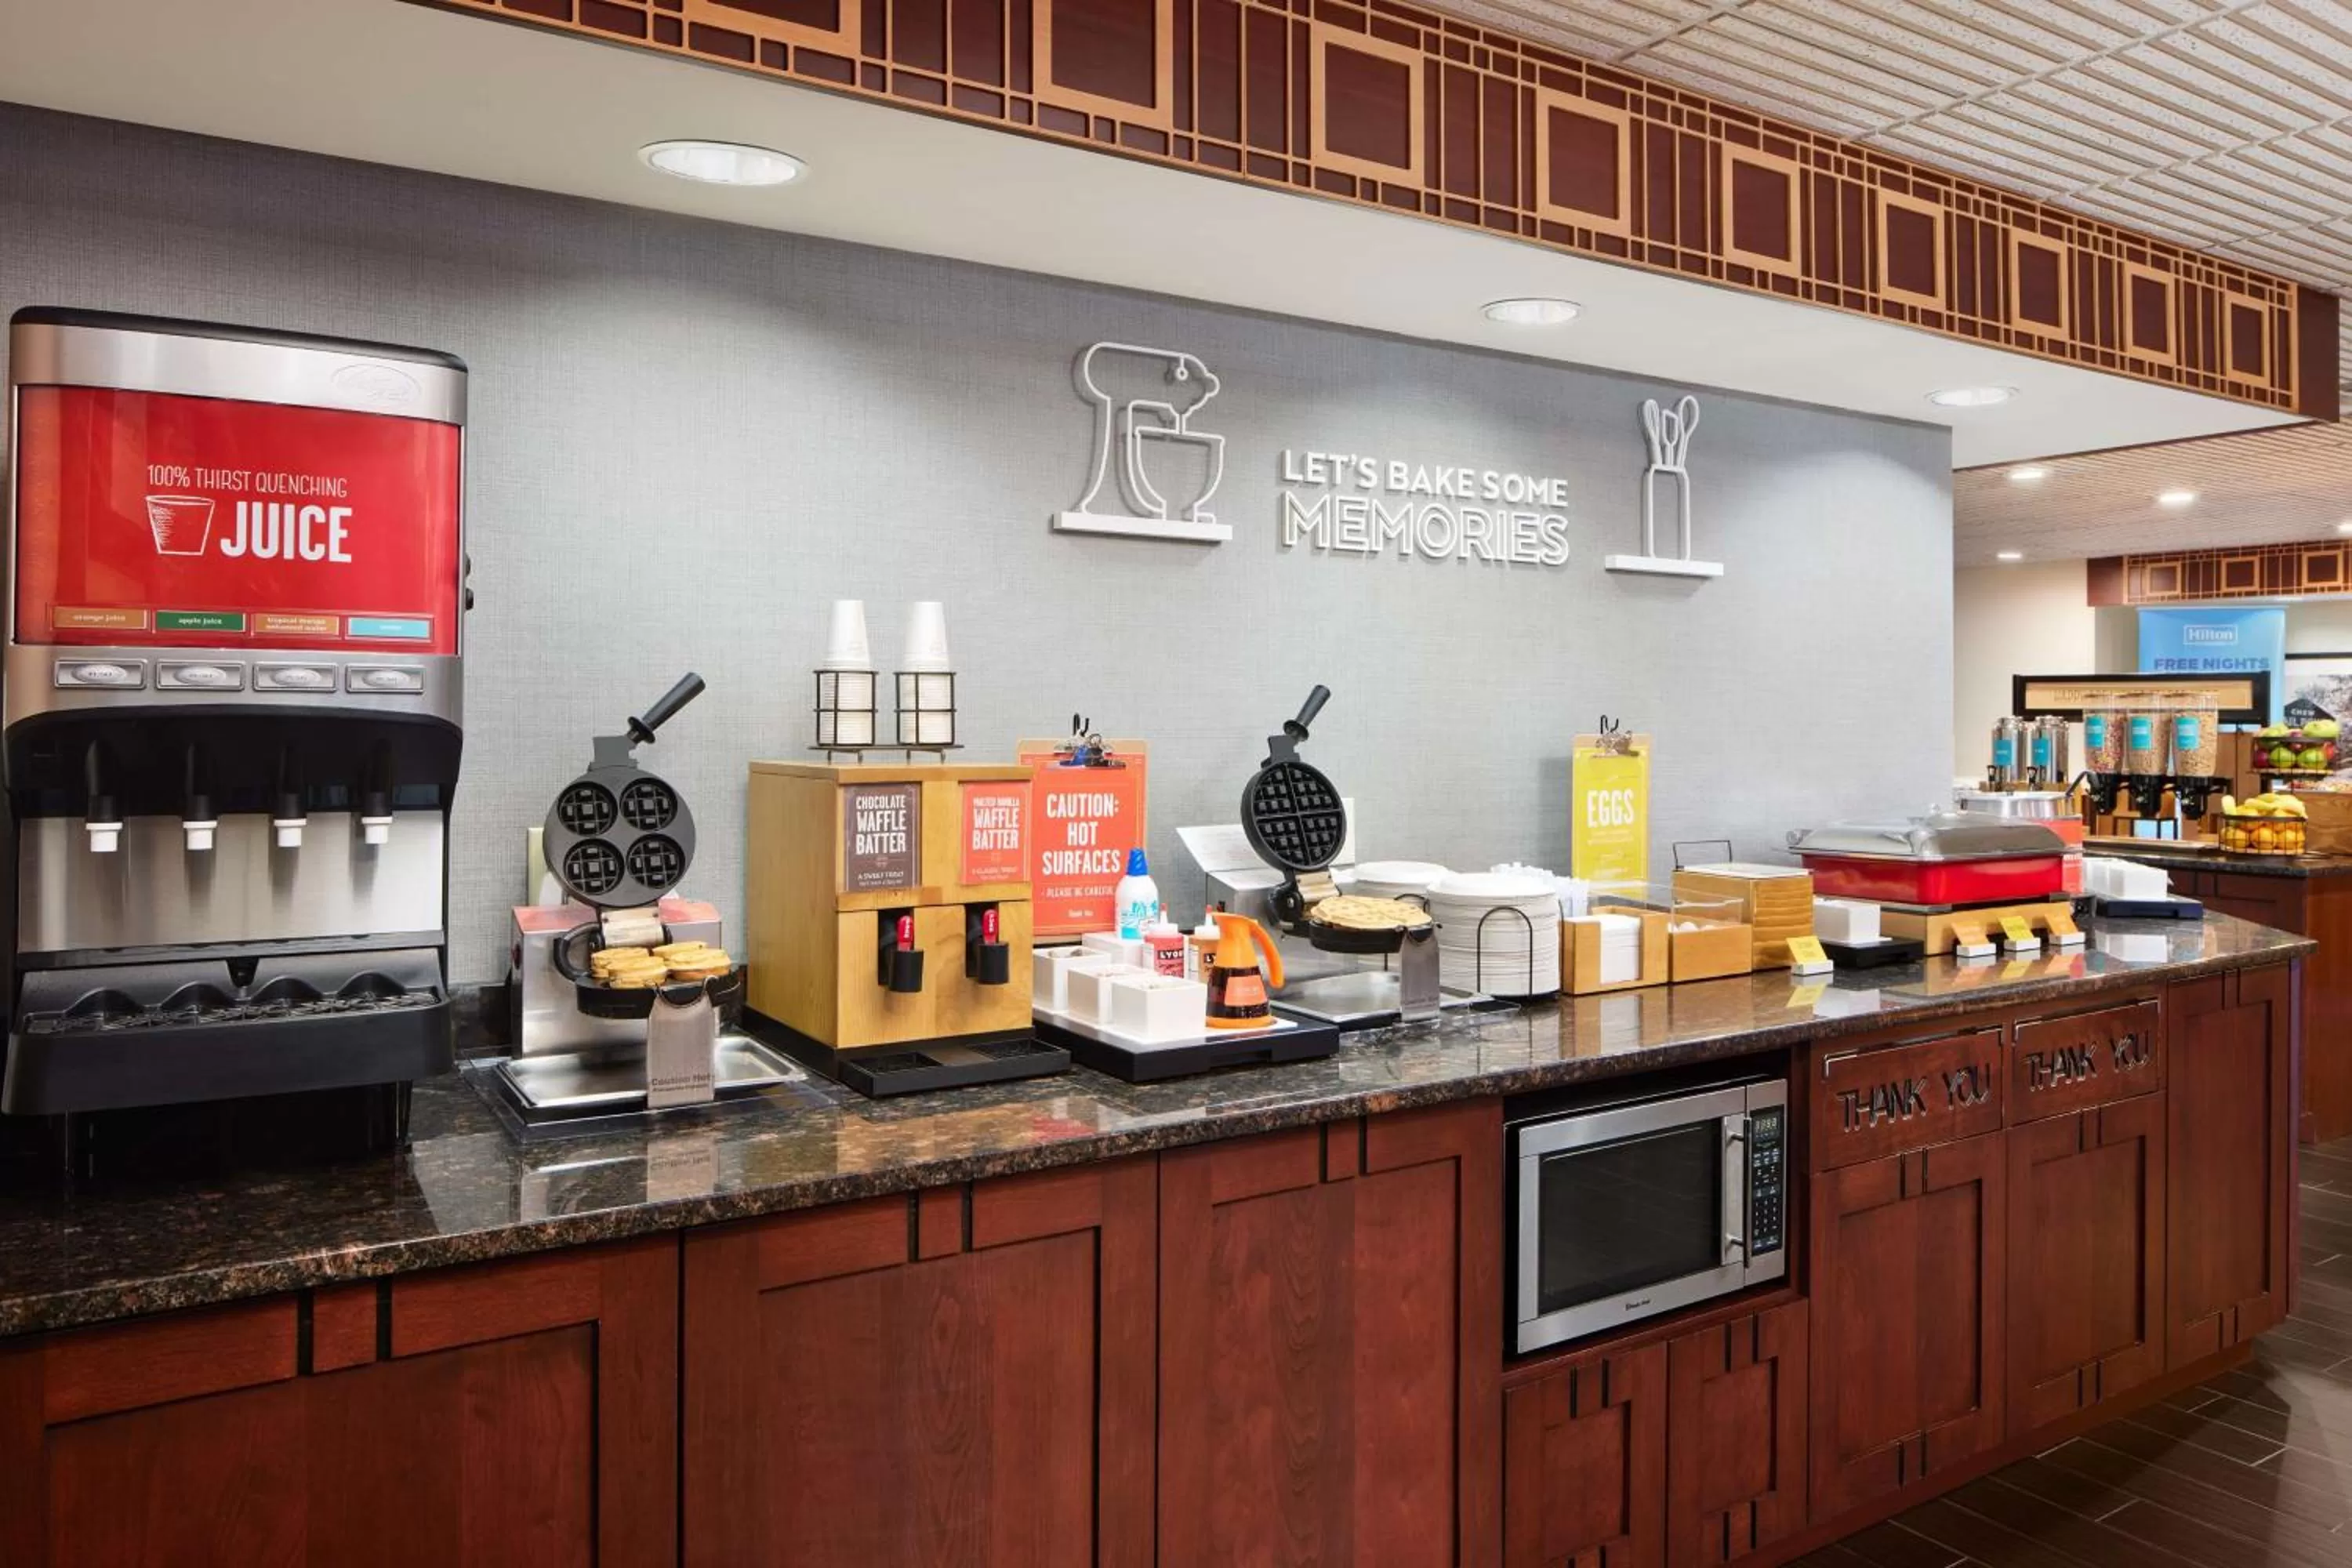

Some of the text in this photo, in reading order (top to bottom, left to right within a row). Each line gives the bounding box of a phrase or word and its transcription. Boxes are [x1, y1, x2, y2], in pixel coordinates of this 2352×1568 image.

[147, 465, 347, 499] 100% THIRST QUENCHING
[1282, 449, 1568, 507] LET'S BAKE SOME
[220, 501, 352, 563] JUICE
[1281, 490, 1569, 566] MEMORIES
[2188, 628, 2233, 641] Hilton
[2154, 657, 2270, 670] FREE NIGHTS
[855, 794, 906, 810] CHOCOLATE
[1047, 792, 1120, 818] CAUTION:
[1586, 788, 1635, 829] EGGS
[856, 810, 907, 832] WAFFLE
[974, 807, 1020, 829] WAFFLE
[855, 832, 906, 855] BATTER
[972, 829, 1018, 851] BATTER
[1067, 821, 1098, 846] HOT
[1042, 849, 1121, 876] SURFACES
[2025, 1028, 2150, 1092] THANK YOU
[1837, 1062, 1991, 1133] THANK YOU
